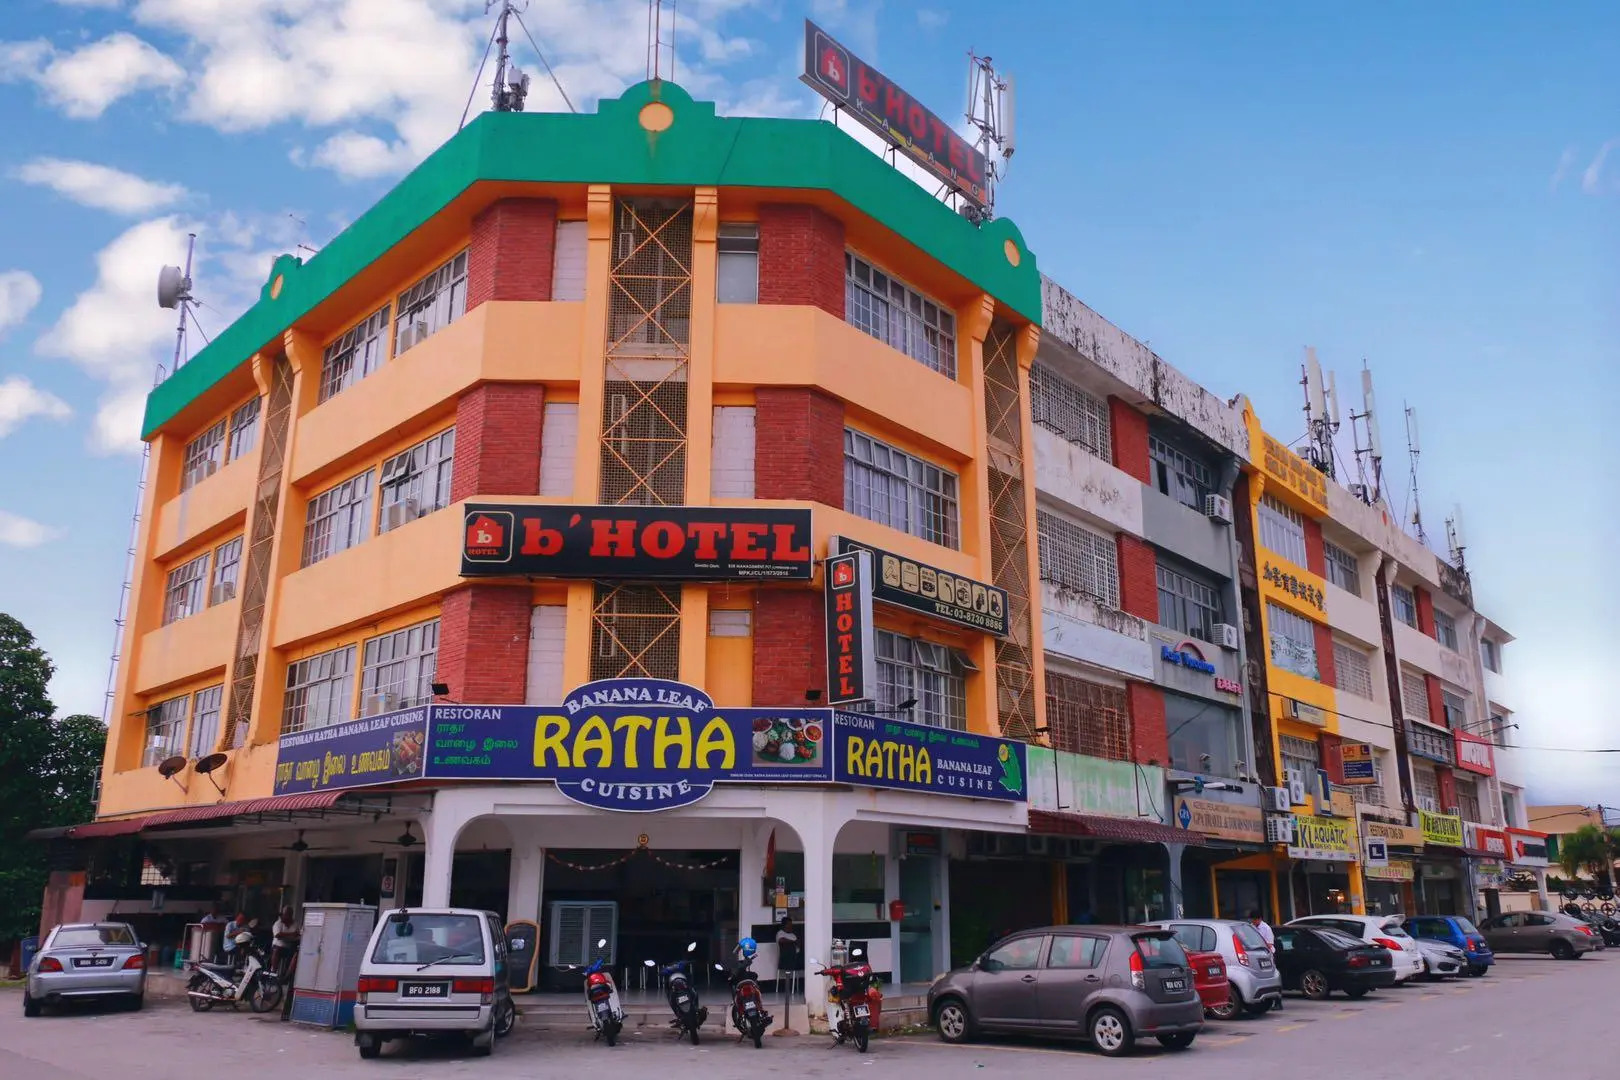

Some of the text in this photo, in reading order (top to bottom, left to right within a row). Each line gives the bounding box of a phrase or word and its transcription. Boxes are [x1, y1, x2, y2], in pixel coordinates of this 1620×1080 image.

[857, 98, 979, 195] KAJANG
[468, 548, 500, 556] HOTEL
[935, 603, 954, 617] TEL:
[836, 592, 855, 696] HOTEL
[566, 687, 709, 715] BANANA LEAF
[435, 708, 502, 720] RESTORAN
[834, 713, 875, 730] RESTORAN
[280, 710, 424, 749] RESTORAN RATHA BANANA LEAF CUISINE
[533, 715, 736, 769] RATHA
[848, 736, 932, 785] RATHA
[937, 758, 992, 776] BANANA LEAF
[580, 778, 692, 800] CUISINE
[937, 774, 993, 791] CUSINE
